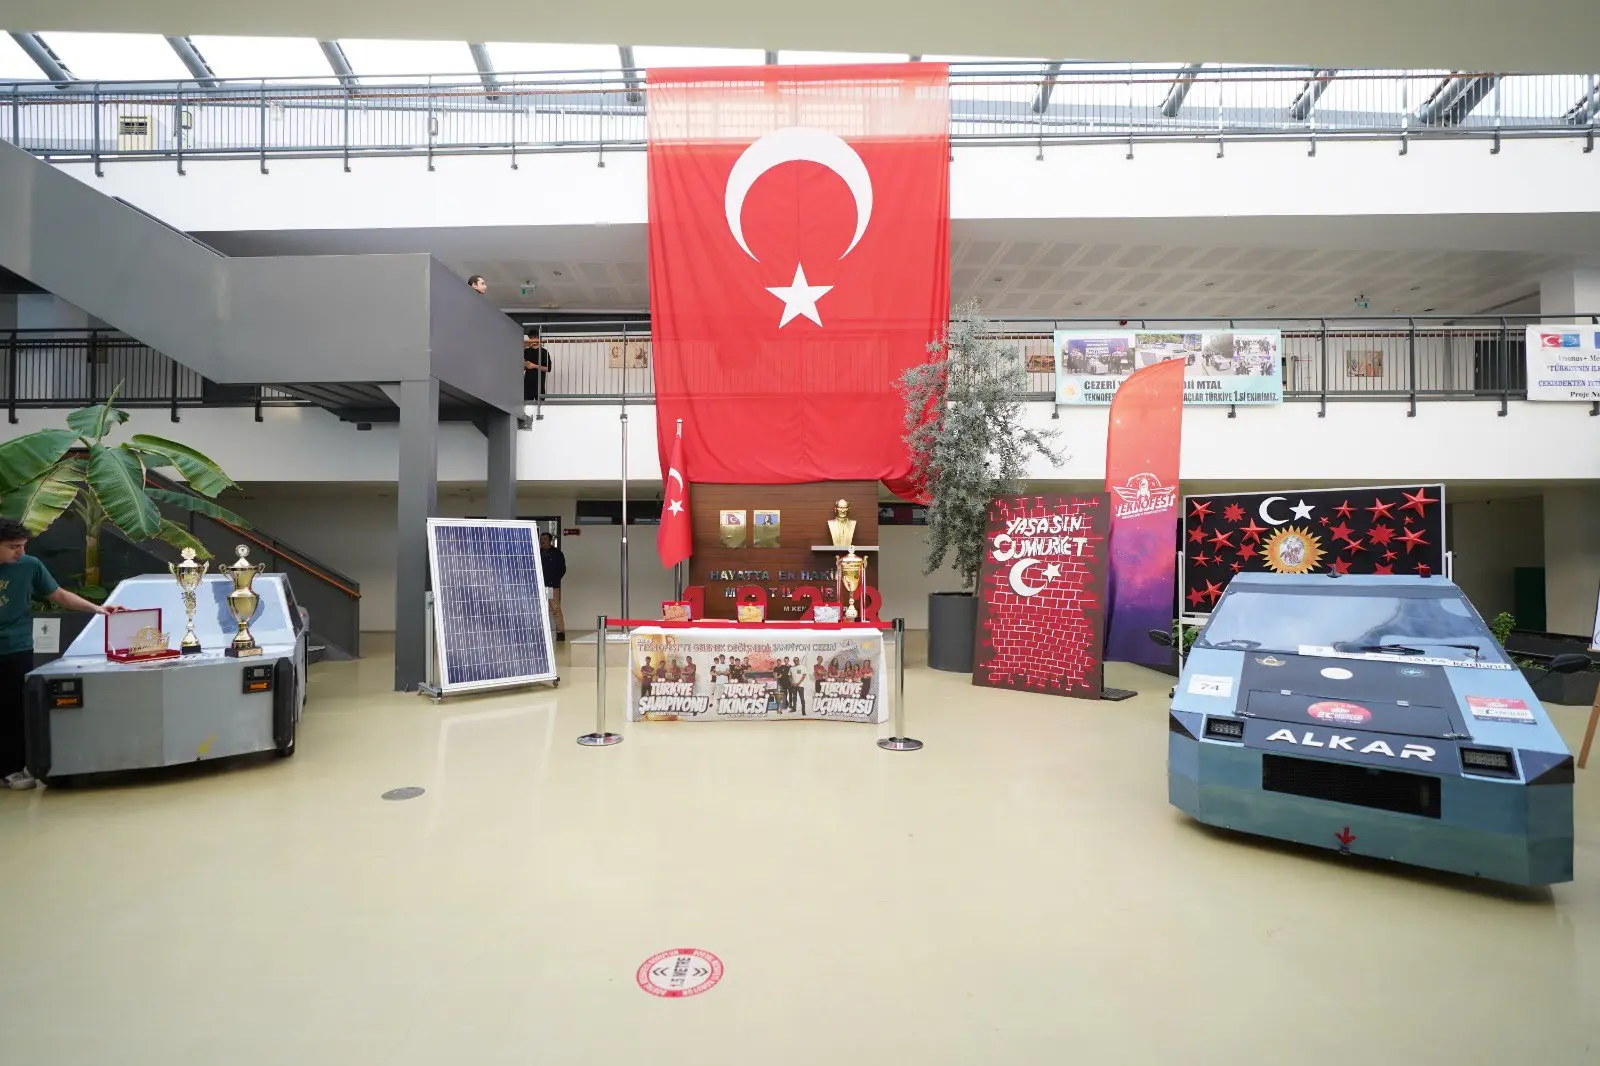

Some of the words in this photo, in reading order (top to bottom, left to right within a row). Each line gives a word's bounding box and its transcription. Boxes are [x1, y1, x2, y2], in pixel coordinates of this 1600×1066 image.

[1196, 380, 1222, 390] MTAL
[1205, 391, 1232, 402] TÜRKİYE
[710, 570, 770, 581] HAYATTA
[778, 570, 797, 580] EN
[1266, 729, 1437, 762] ALKAR
